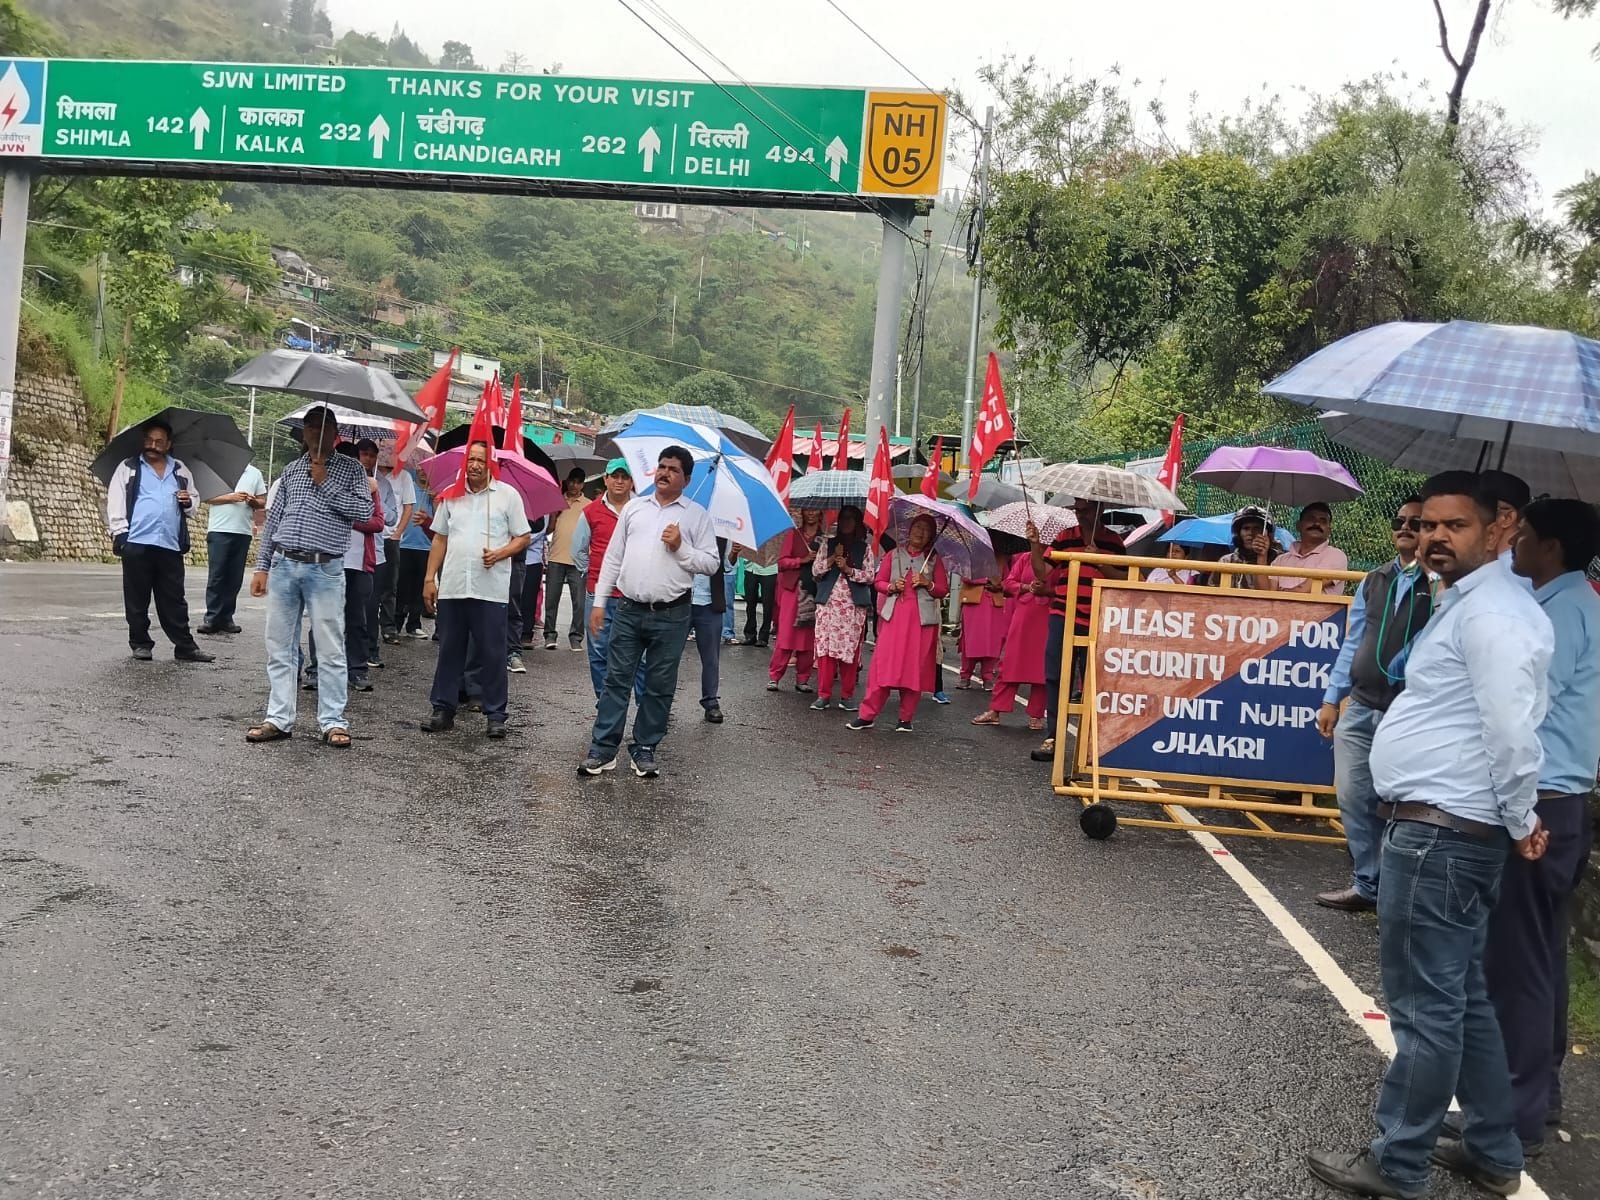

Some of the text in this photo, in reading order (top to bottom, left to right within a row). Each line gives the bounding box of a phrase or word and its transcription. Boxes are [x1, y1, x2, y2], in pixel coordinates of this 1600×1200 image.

[202, 71, 694, 108] SJVN LIMITED THANKS FOR YOUR VISIT
[56, 95, 117, 120] शिमला
[239, 107, 304, 128] कालका
[147, 116, 183, 134] 142
[319, 124, 361, 142] 232
[416, 108, 486, 141] चंडीगढ़
[688, 121, 749, 149] दिल्ली
[884, 113, 925, 137] NH
[55, 128, 131, 148] SHIMLA
[235, 134, 304, 154] KALKA
[581, 136, 626, 155] 262
[413, 143, 561, 167] CHANDIGARH
[684, 157, 750, 176] DELHI
[765, 145, 815, 164] 494
[883, 147, 921, 175] 05
[1103, 606, 1340, 650] PLEASE STOP FOR
[1103, 647, 1331, 689] SECURITY CHECK
[1095, 691, 1148, 716] CISF
[1163, 697, 1224, 721] UNIT
[1152, 731, 1266, 760] JHAKRI
